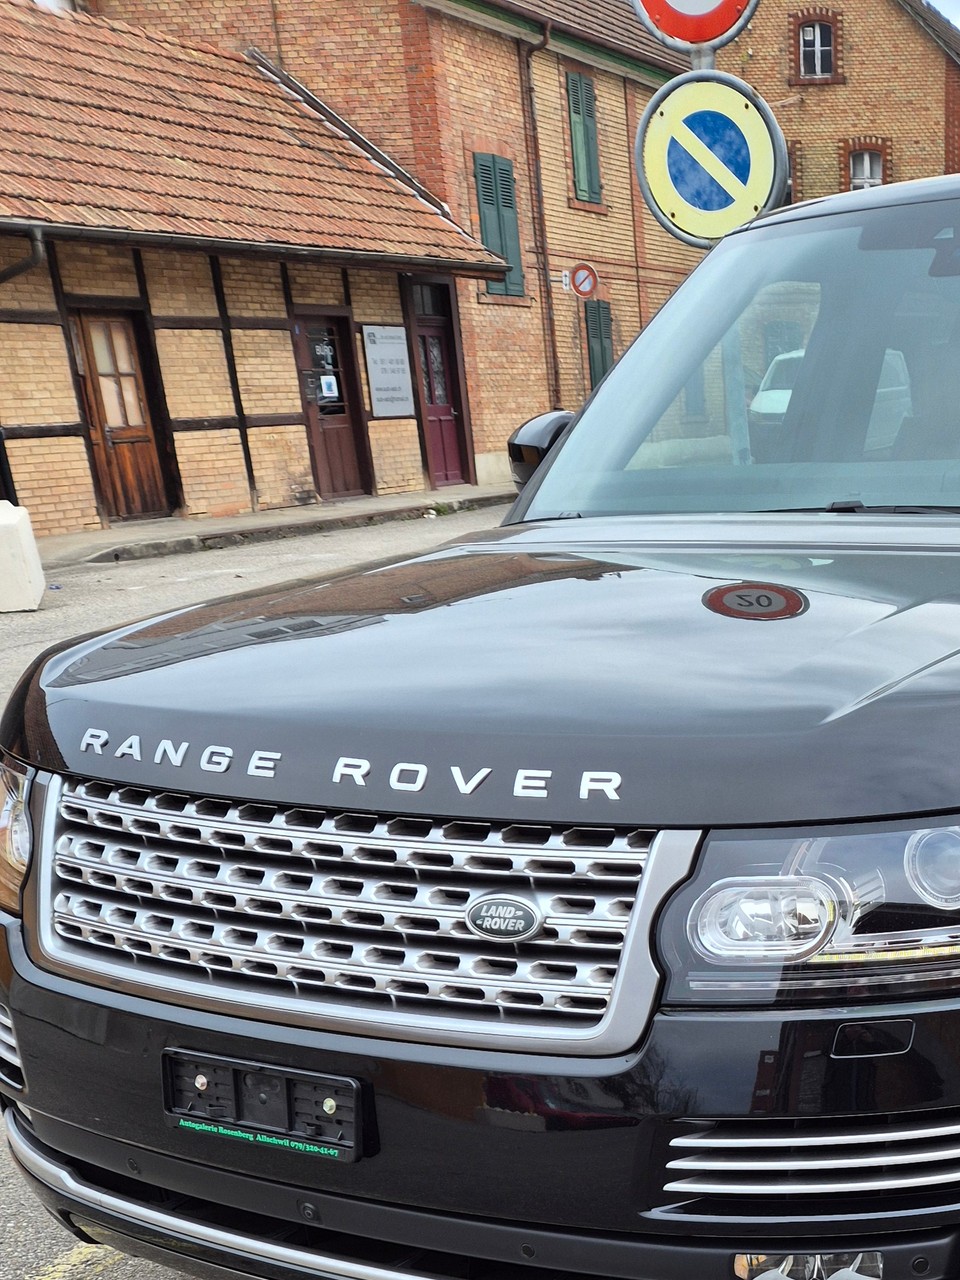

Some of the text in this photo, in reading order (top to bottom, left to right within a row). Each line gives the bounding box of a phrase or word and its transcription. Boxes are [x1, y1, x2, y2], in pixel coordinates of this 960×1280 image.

[79, 727, 623, 800] RANGE ROVER
[480, 905, 515, 918] LAND
[482, 917, 525, 931] ROVER
[179, 1118, 218, 1133] Autogalerie
[218, 1126, 254, 1141] Rosenberg
[255, 1133, 290, 1147] Allschwil
